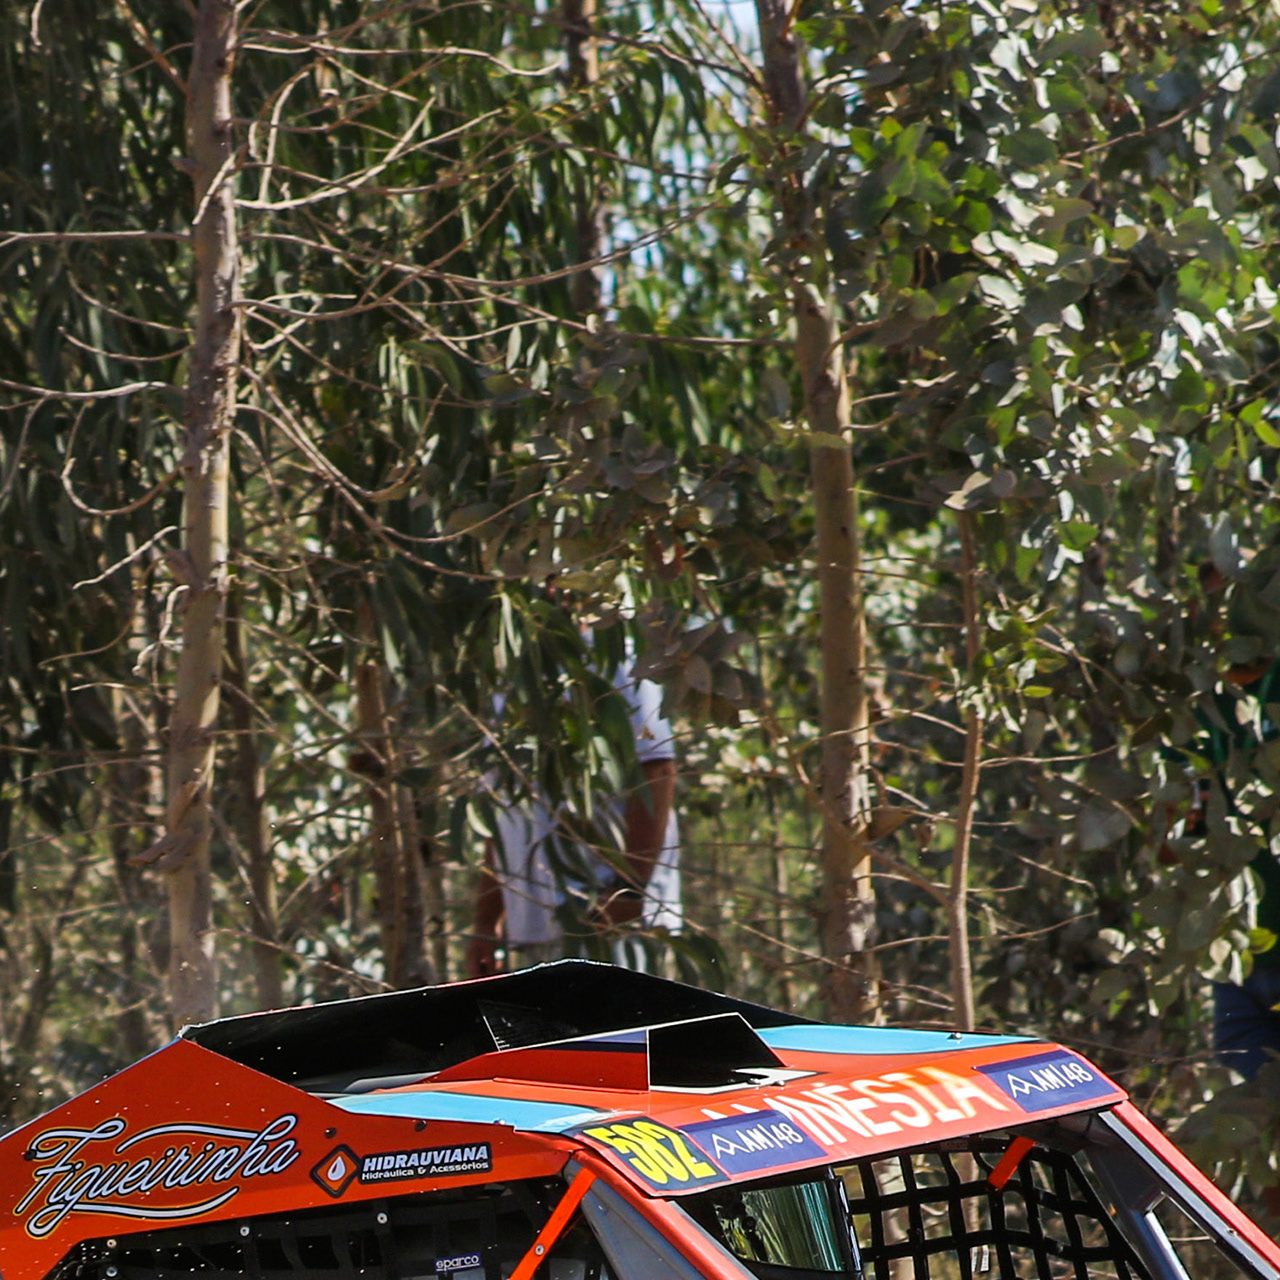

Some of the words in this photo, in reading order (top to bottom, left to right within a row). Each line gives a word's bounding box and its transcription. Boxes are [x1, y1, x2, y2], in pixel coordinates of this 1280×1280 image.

[701, 1066, 1011, 1147] NESIA
[13, 1114, 300, 1237] Figueirinha
[361, 1168, 415, 1181] Hidráulica
[363, 1146, 488, 1172] HIDRAUVIANA
[582, 1121, 718, 1185] 582
